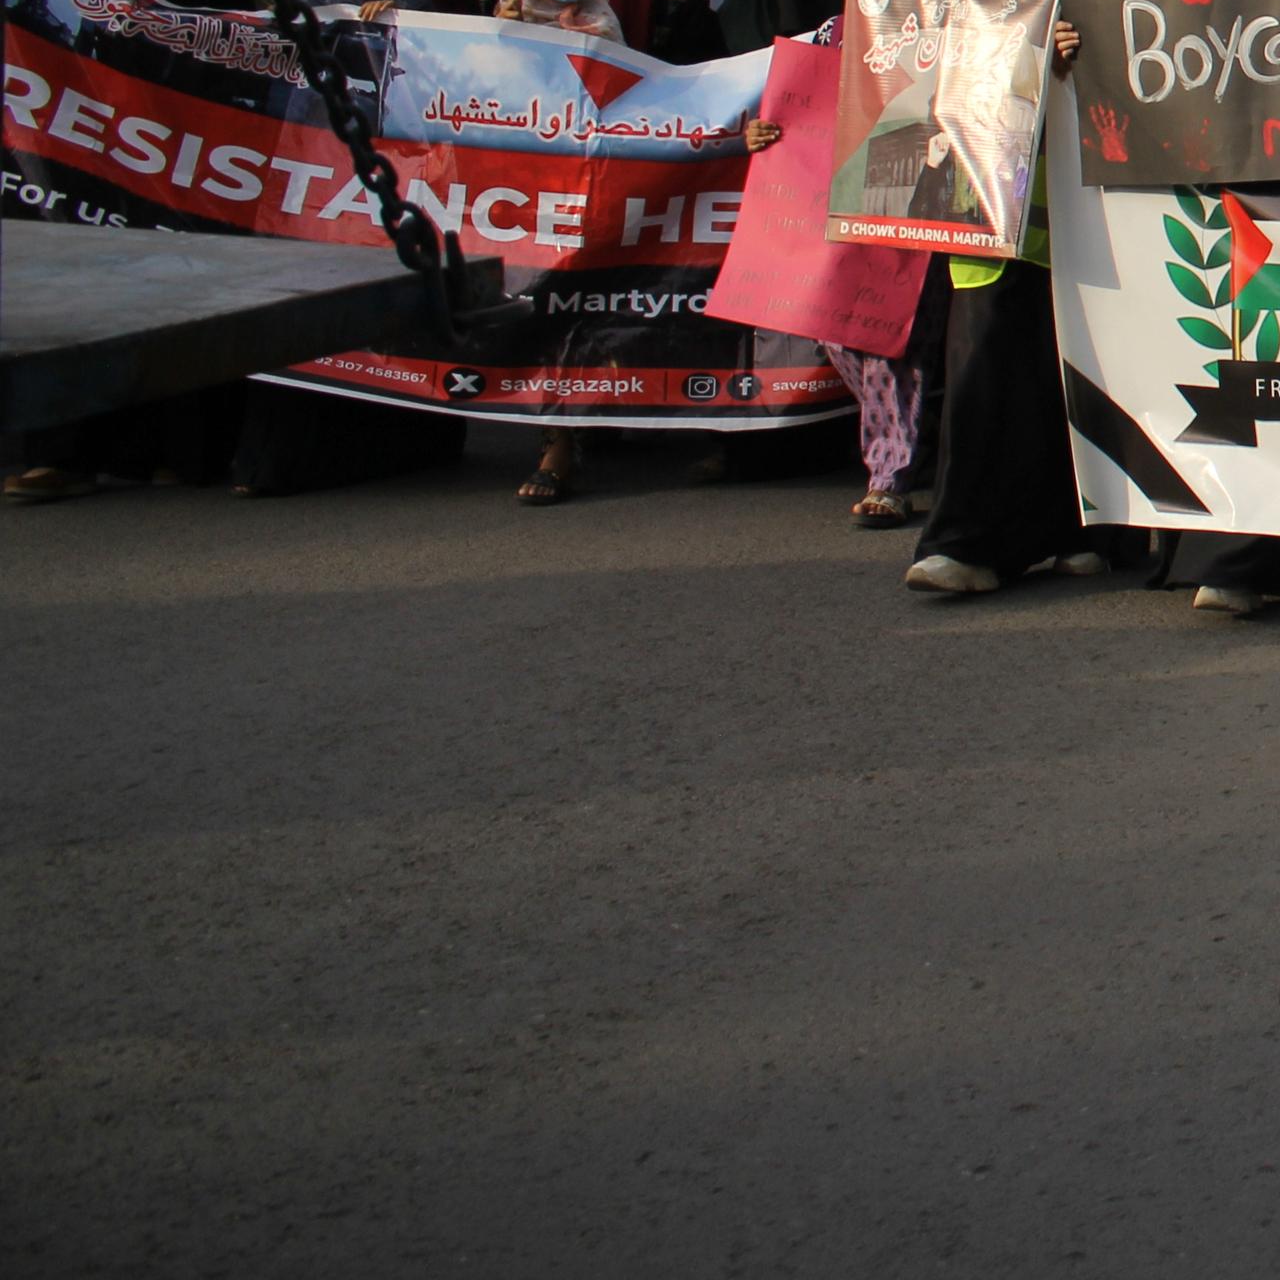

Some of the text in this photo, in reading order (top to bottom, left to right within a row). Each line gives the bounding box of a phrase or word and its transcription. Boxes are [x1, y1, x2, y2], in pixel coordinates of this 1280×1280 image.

[840, 222, 1005, 248] D CHOWK DHARNA MARTYR
[335, 360, 427, 383] 307 4583567
[500, 374, 645, 397] savegazapk
